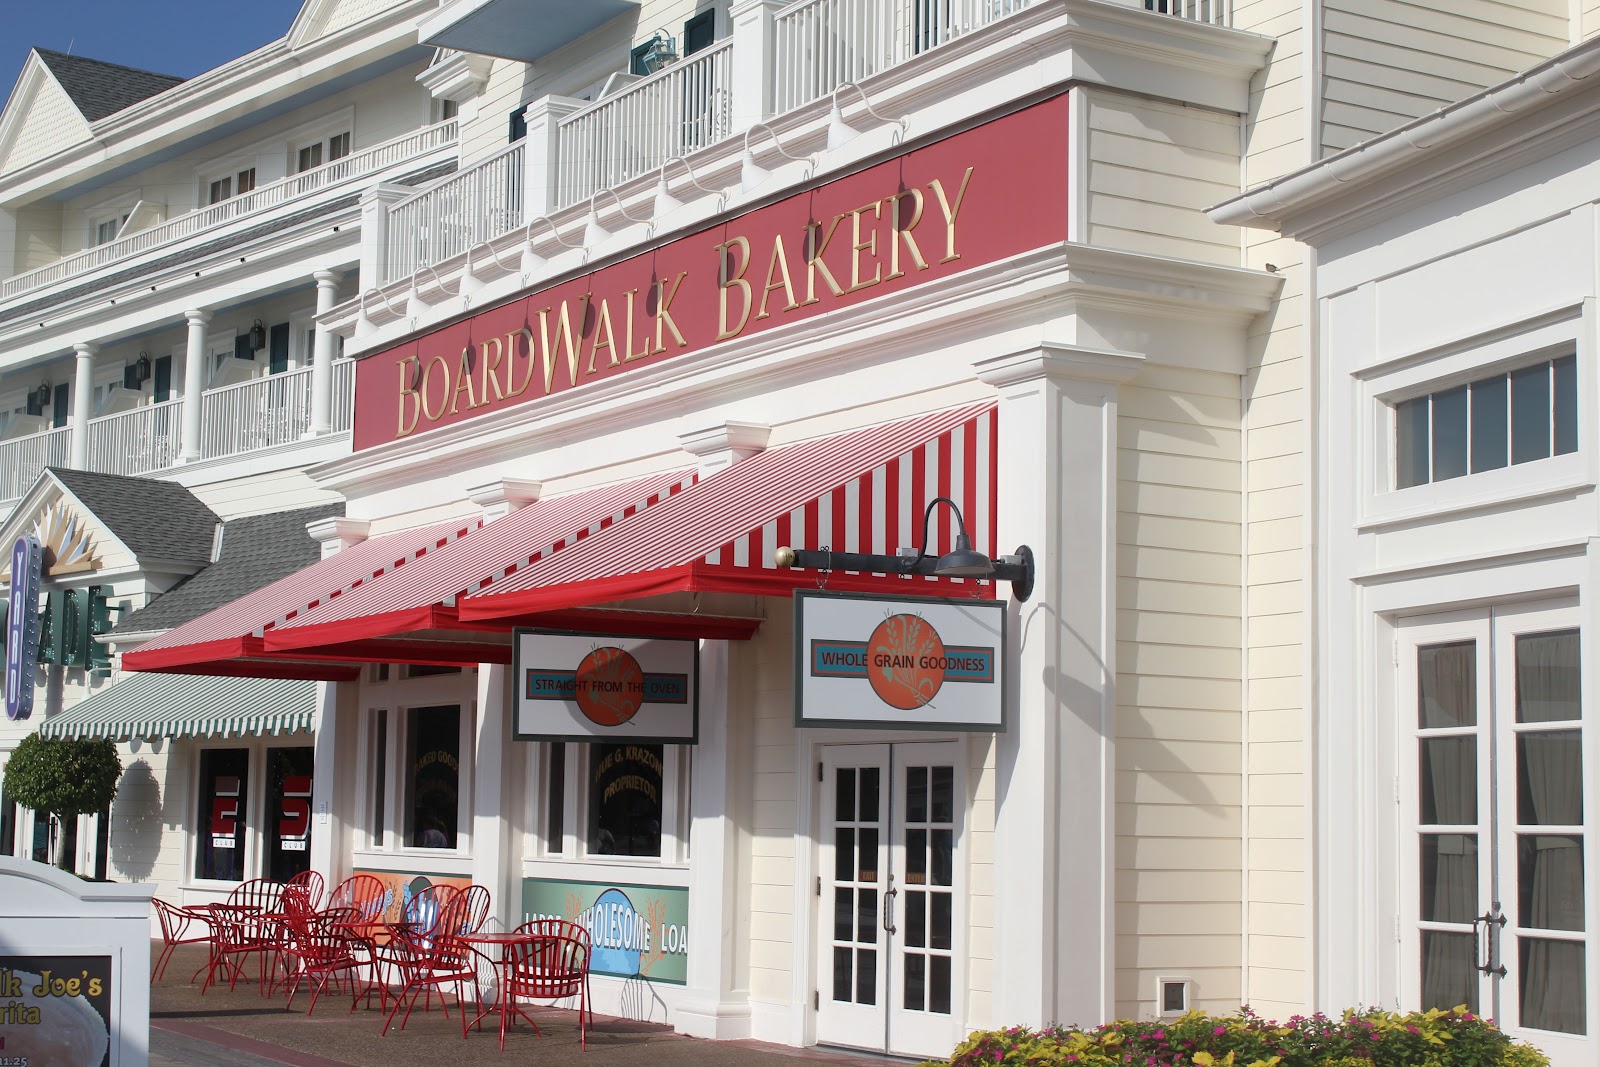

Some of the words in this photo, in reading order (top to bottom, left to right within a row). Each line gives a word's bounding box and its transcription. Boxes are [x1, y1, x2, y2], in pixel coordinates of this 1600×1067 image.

[395, 270, 689, 439] BOARDWALK
[713, 166, 975, 343] BAKERY
[9, 551, 24, 704] YARD
[821, 651, 869, 667] WHOLE
[873, 653, 915, 669] GRAIN
[919, 656, 985, 672] GOODNESS
[534, 678, 588, 692] STRAIGHT
[592, 680, 623, 693] FROM
[627, 682, 646, 694] THE
[650, 682, 680, 695] OVEN
[625, 745, 663, 778] KRAZON
[603, 774, 657, 805] PROPRIETOR
[214, 839, 234, 847] CLUB
[283, 841, 305, 849] CLUB
[862, 871, 875, 881] EXIT
[574, 902, 652, 953] WHOLESOME
[32, 970, 103, 998] Joe's
